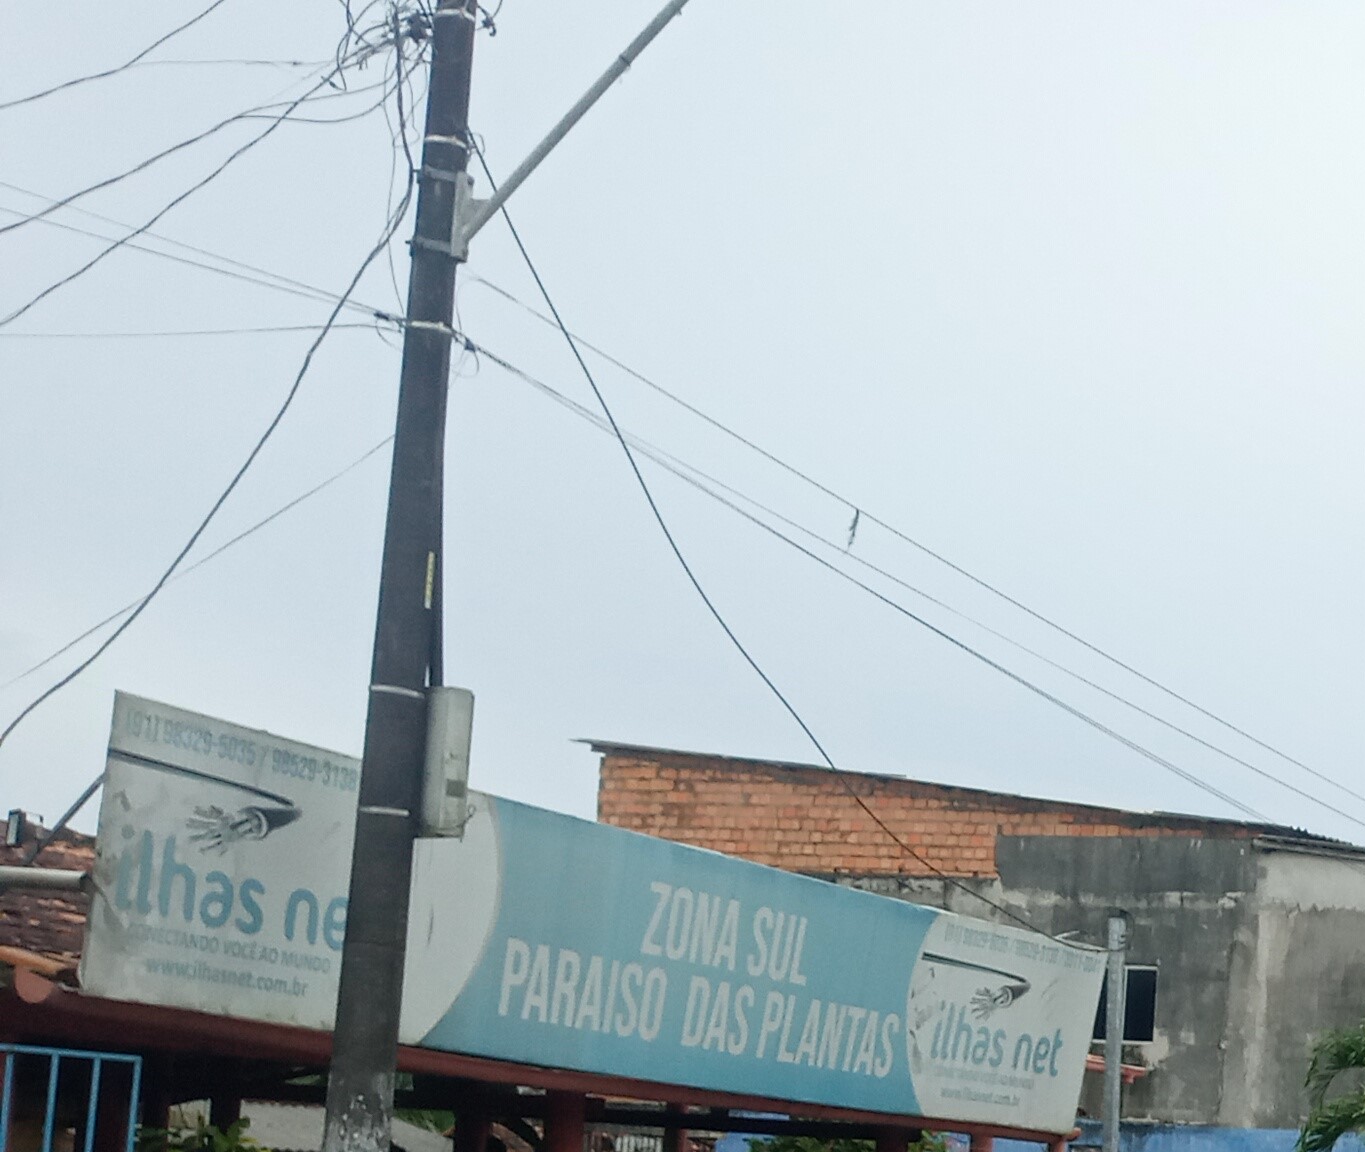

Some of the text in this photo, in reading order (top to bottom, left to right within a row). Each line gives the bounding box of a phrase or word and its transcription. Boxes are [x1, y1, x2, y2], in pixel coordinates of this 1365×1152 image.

[115, 823, 350, 951] ilhas ne
[640, 880, 809, 987] ZONA SUL
[280, 951, 331, 974] MUNDO
[497, 935, 900, 1080] PARAISO DAS PLANTAS
[930, 1000, 1007, 1068] ilhas
[1012, 1027, 1063, 1078] net
